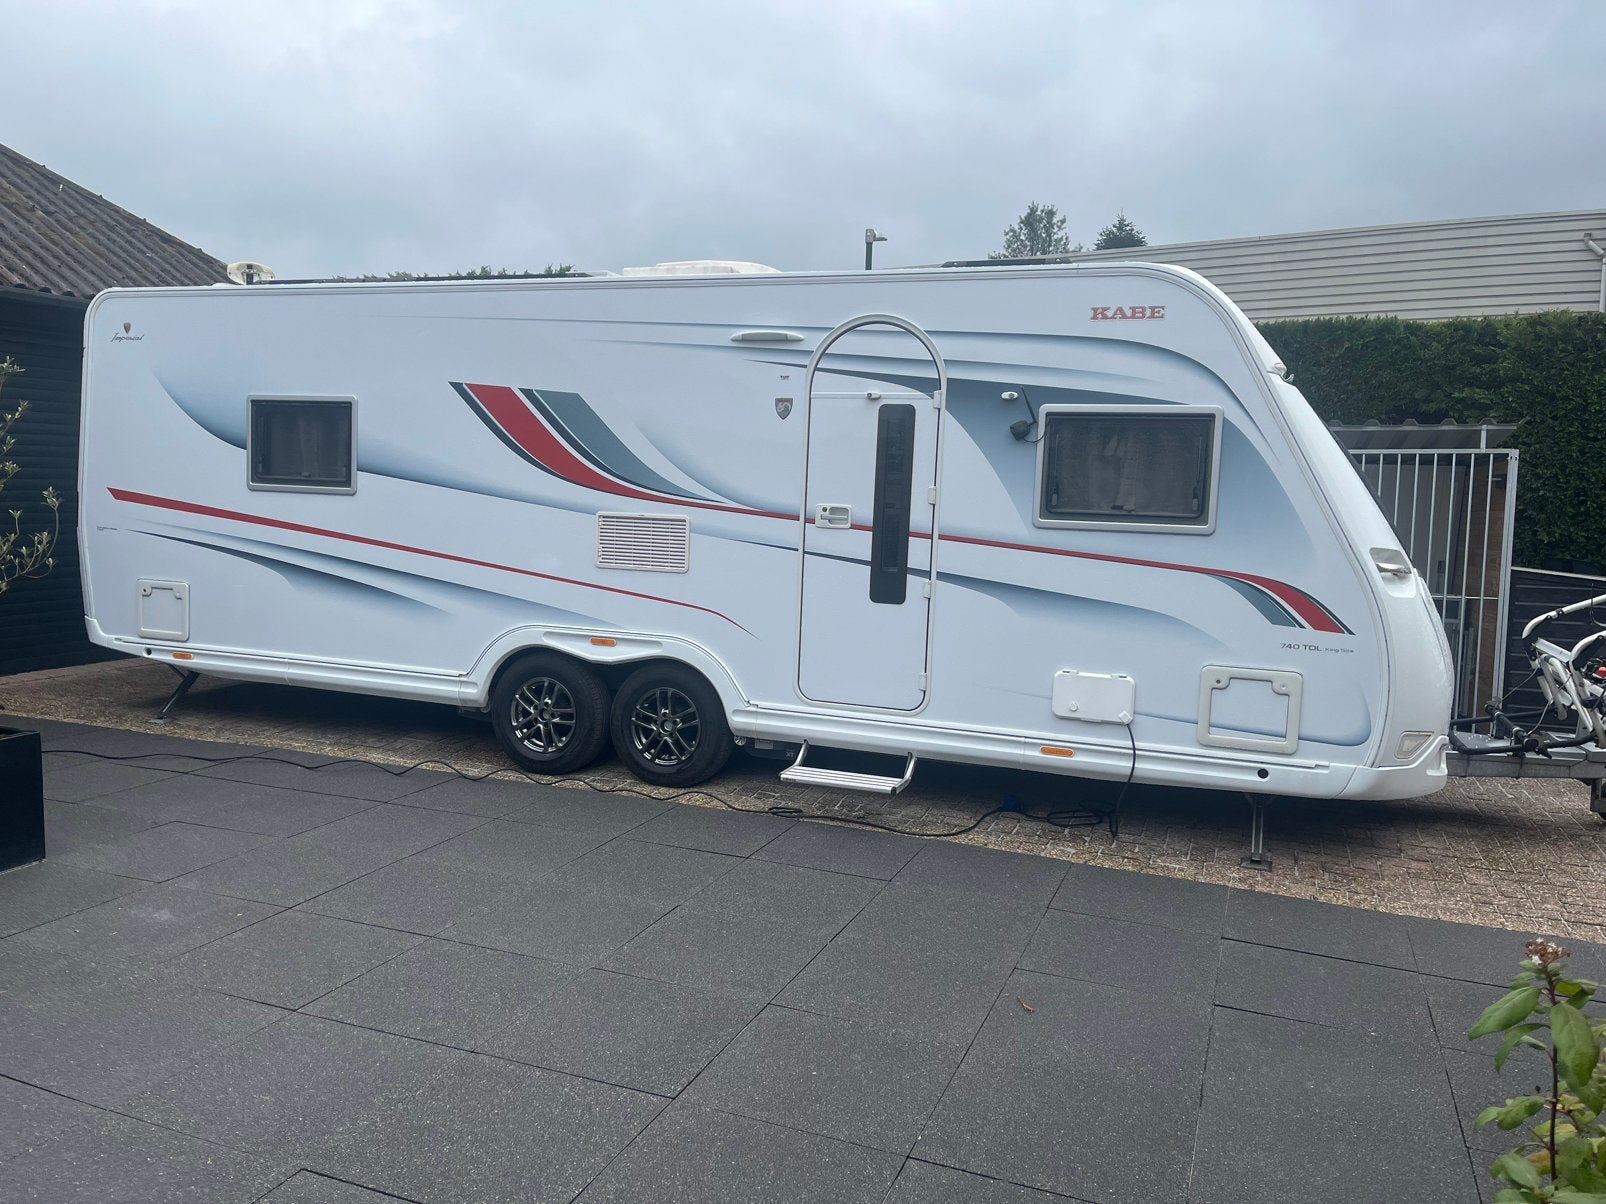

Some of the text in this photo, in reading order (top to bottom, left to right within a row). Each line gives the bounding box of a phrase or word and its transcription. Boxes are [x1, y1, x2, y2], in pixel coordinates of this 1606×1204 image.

[1090, 305, 1166, 321] KABE
[1279, 642, 1300, 650] 740
[1302, 644, 1323, 652] TDL
